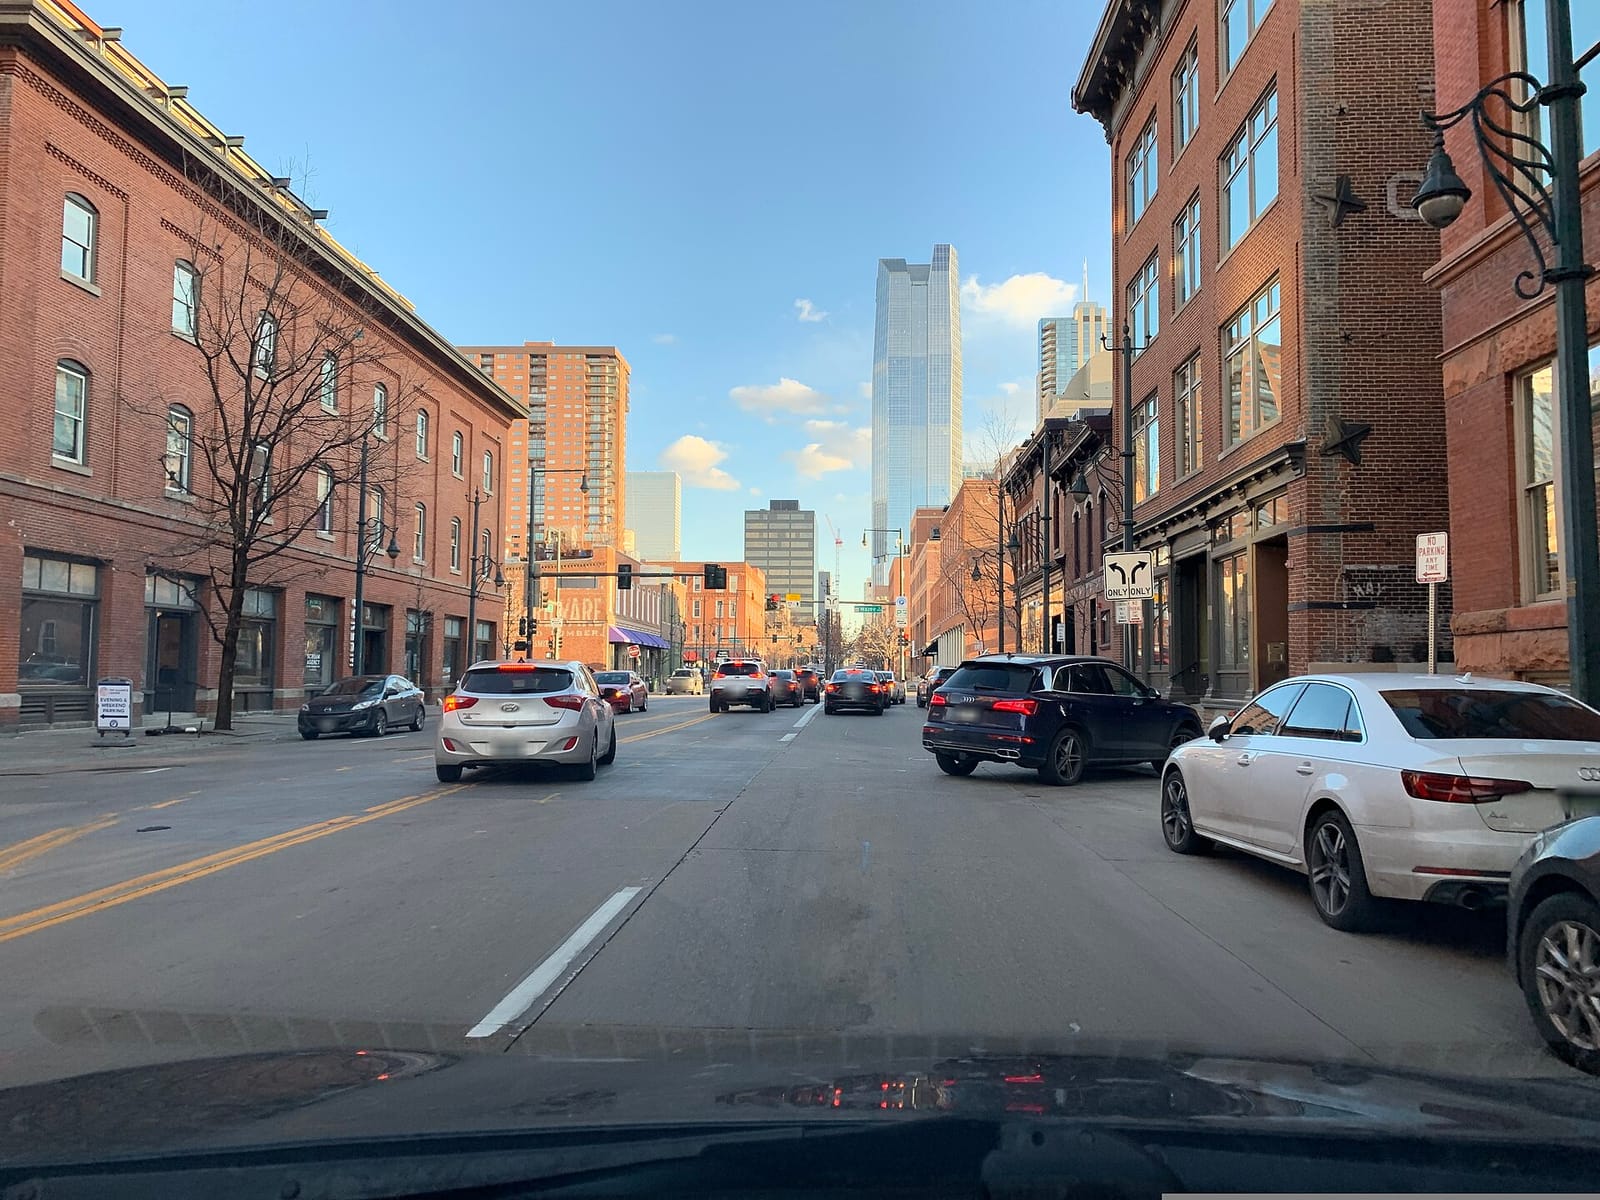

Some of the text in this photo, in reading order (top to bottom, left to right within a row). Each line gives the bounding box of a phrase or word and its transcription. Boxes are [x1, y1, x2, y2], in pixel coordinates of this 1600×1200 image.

[1427, 536, 1437, 546] NO
[1419, 546, 1445, 556] PARKING
[1108, 587, 1151, 597] ONLY ONLY
